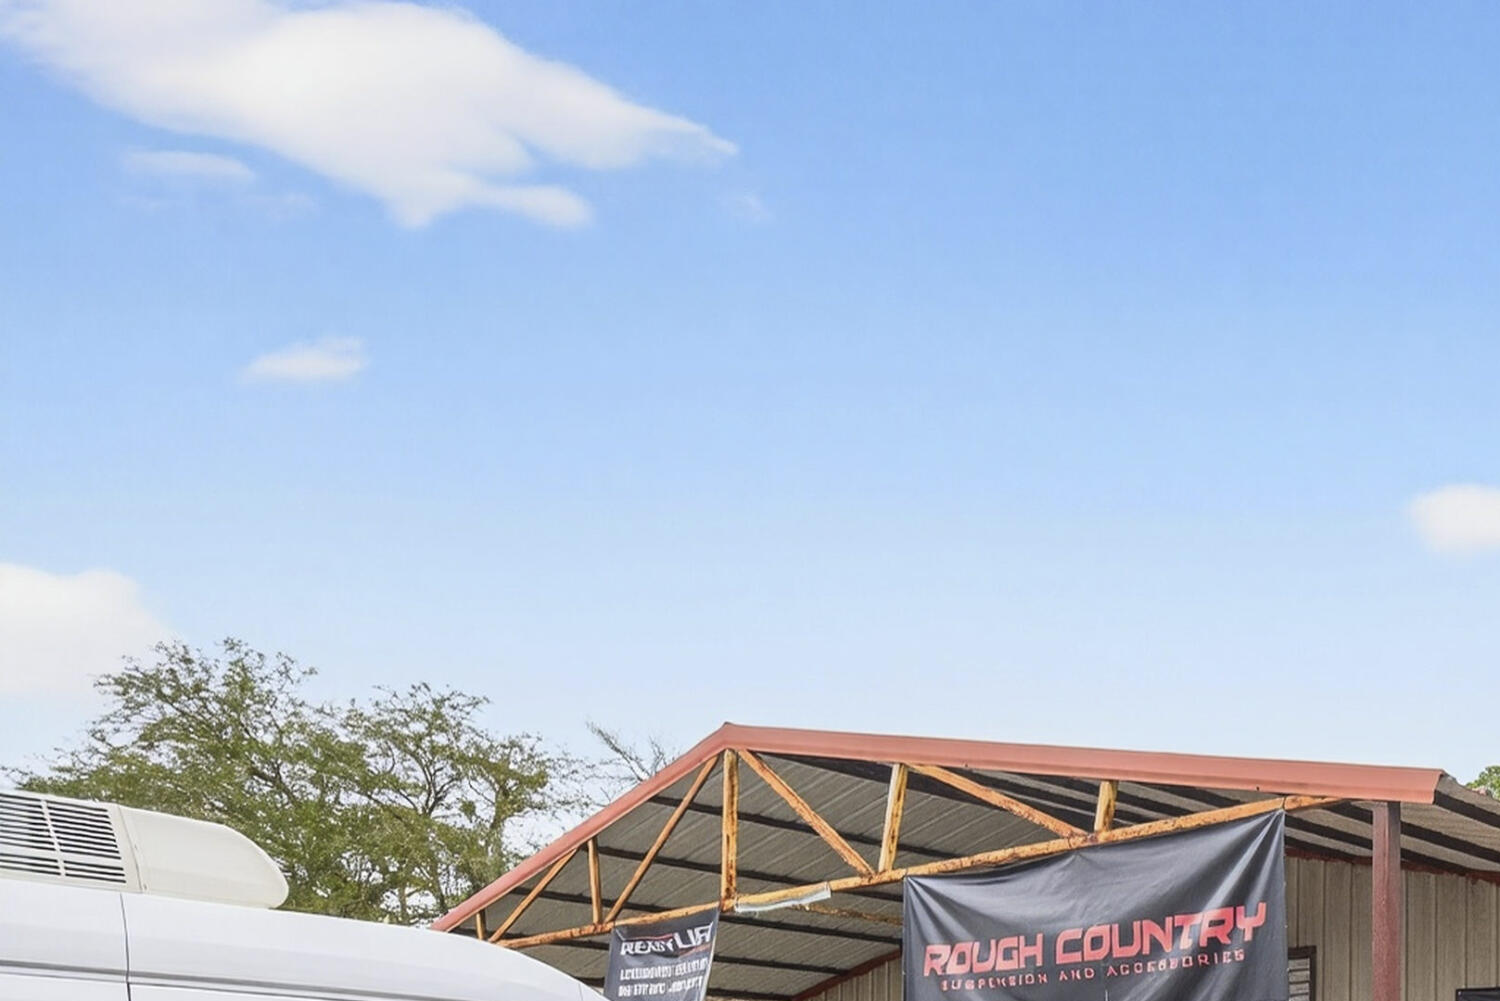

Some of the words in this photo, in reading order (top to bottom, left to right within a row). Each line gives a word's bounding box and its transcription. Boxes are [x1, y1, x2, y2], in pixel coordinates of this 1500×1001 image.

[924, 932, 1044, 977] ROUGH
[1056, 902, 1267, 965] COUNTRY
[1058, 968, 1095, 982] AND
